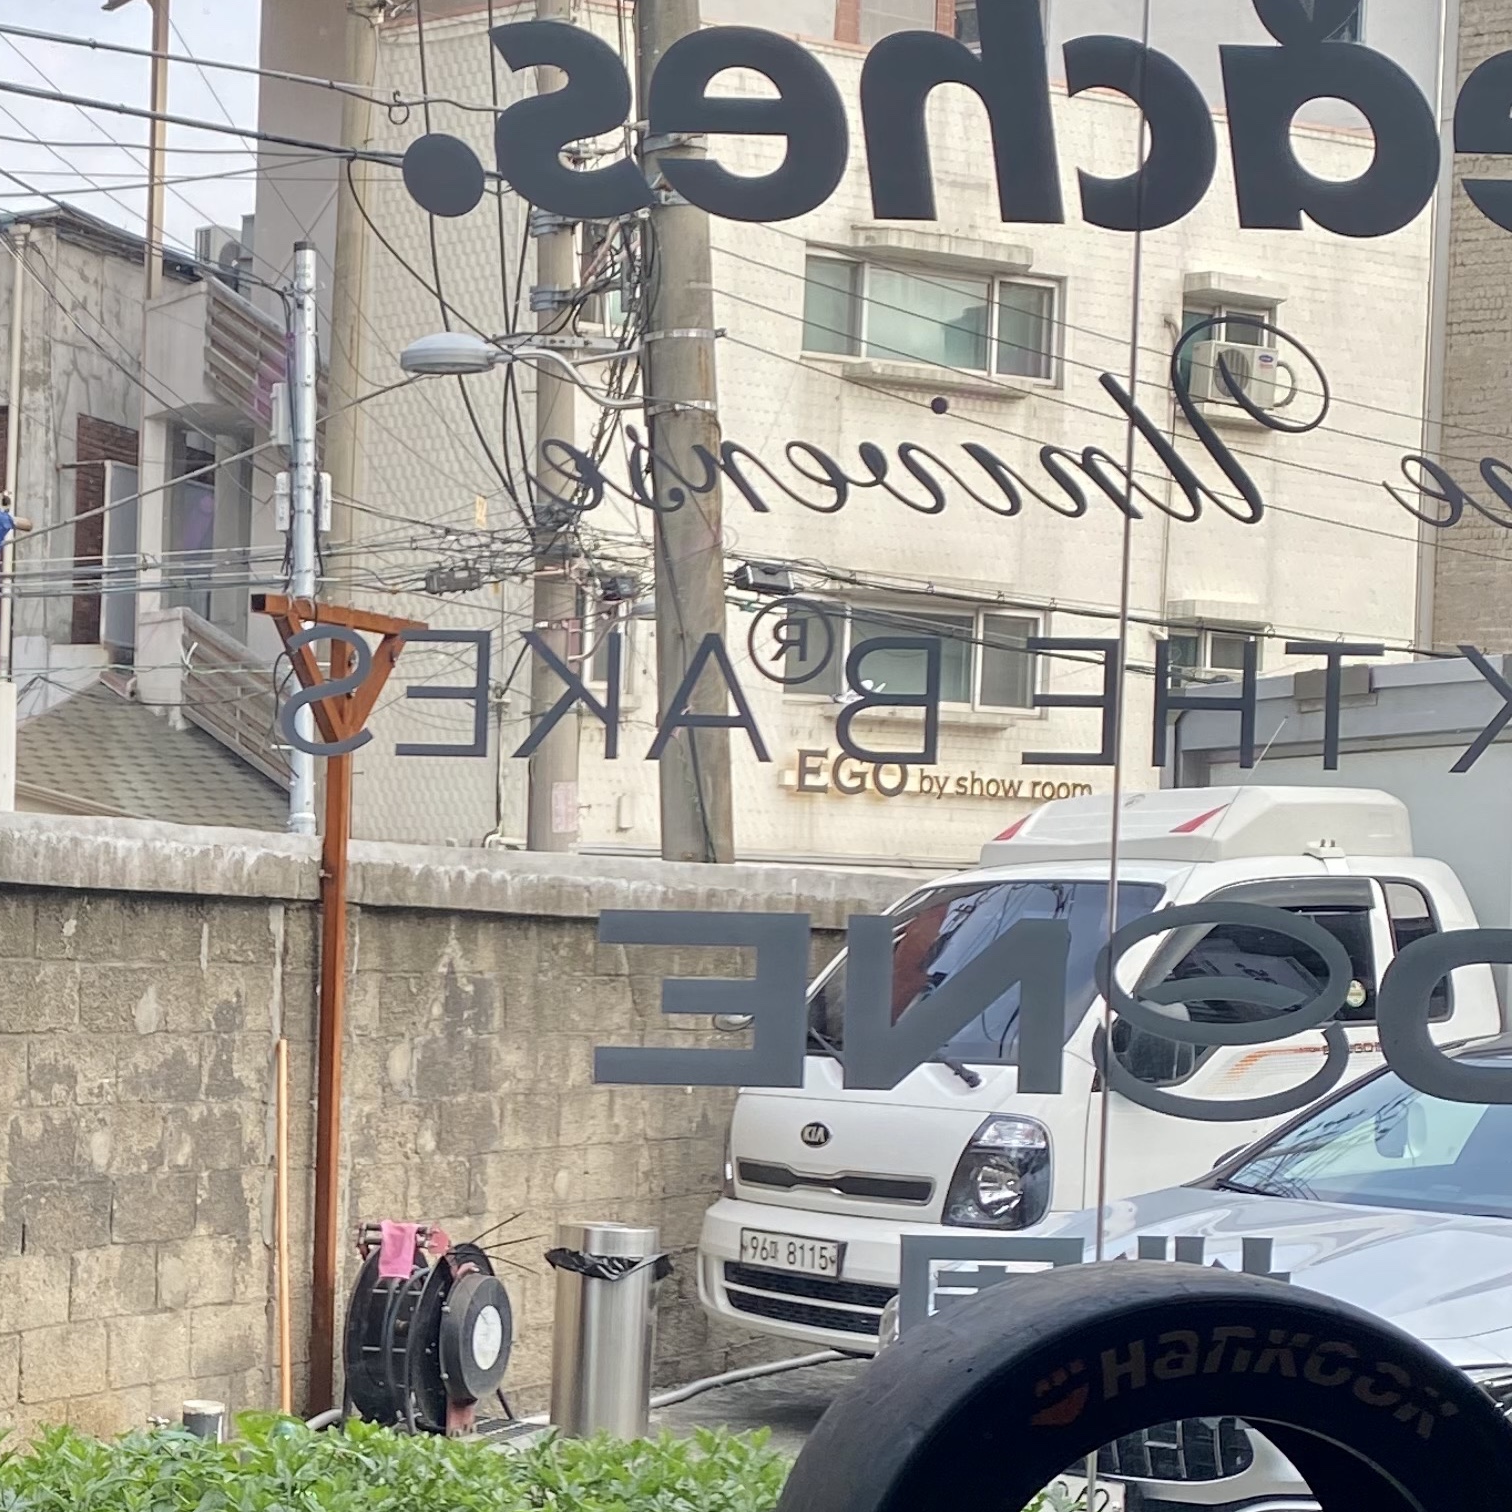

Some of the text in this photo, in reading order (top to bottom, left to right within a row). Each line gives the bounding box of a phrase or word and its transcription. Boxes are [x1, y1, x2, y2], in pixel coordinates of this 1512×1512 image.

[796, 748, 1093, 800] EGO by show room
[787, 1241, 829, 1271] 8115
